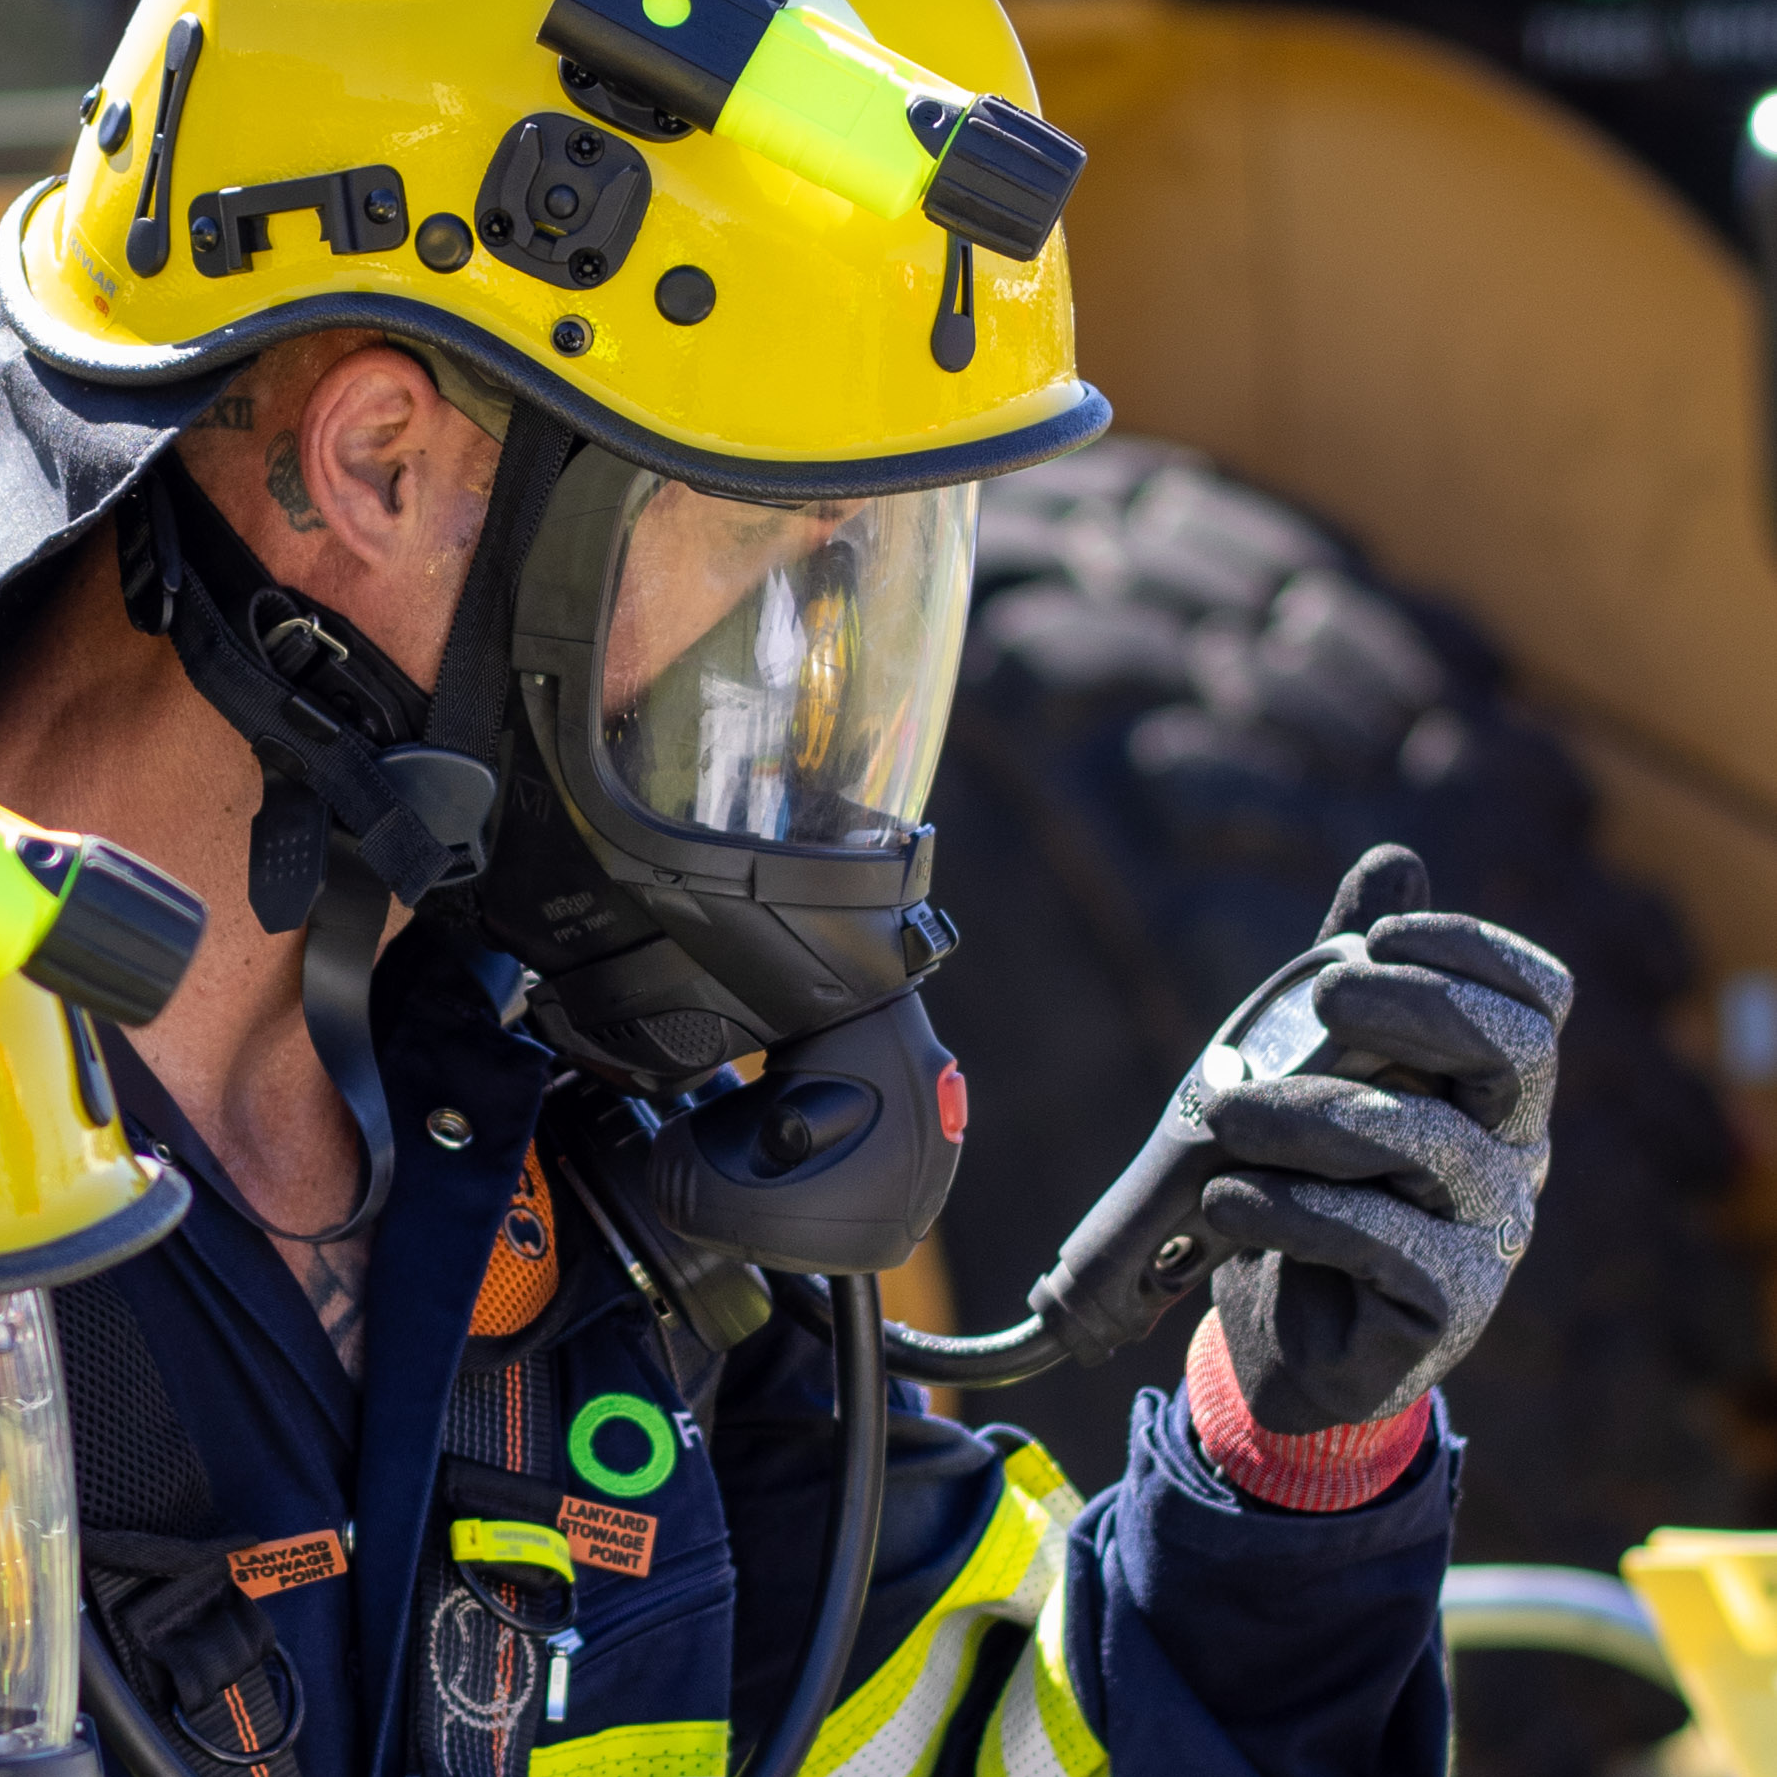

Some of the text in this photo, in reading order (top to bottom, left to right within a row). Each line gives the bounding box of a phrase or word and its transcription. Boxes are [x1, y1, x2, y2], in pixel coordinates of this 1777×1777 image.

[565, 1500, 650, 1534] LANYARD
[559, 1517, 646, 1552] STOWAGE
[234, 1540, 329, 1567] LANYARD
[235, 1551, 334, 1582] STOWAGE
[588, 1543, 642, 1570] POINT
[278, 1562, 335, 1588] POINT
